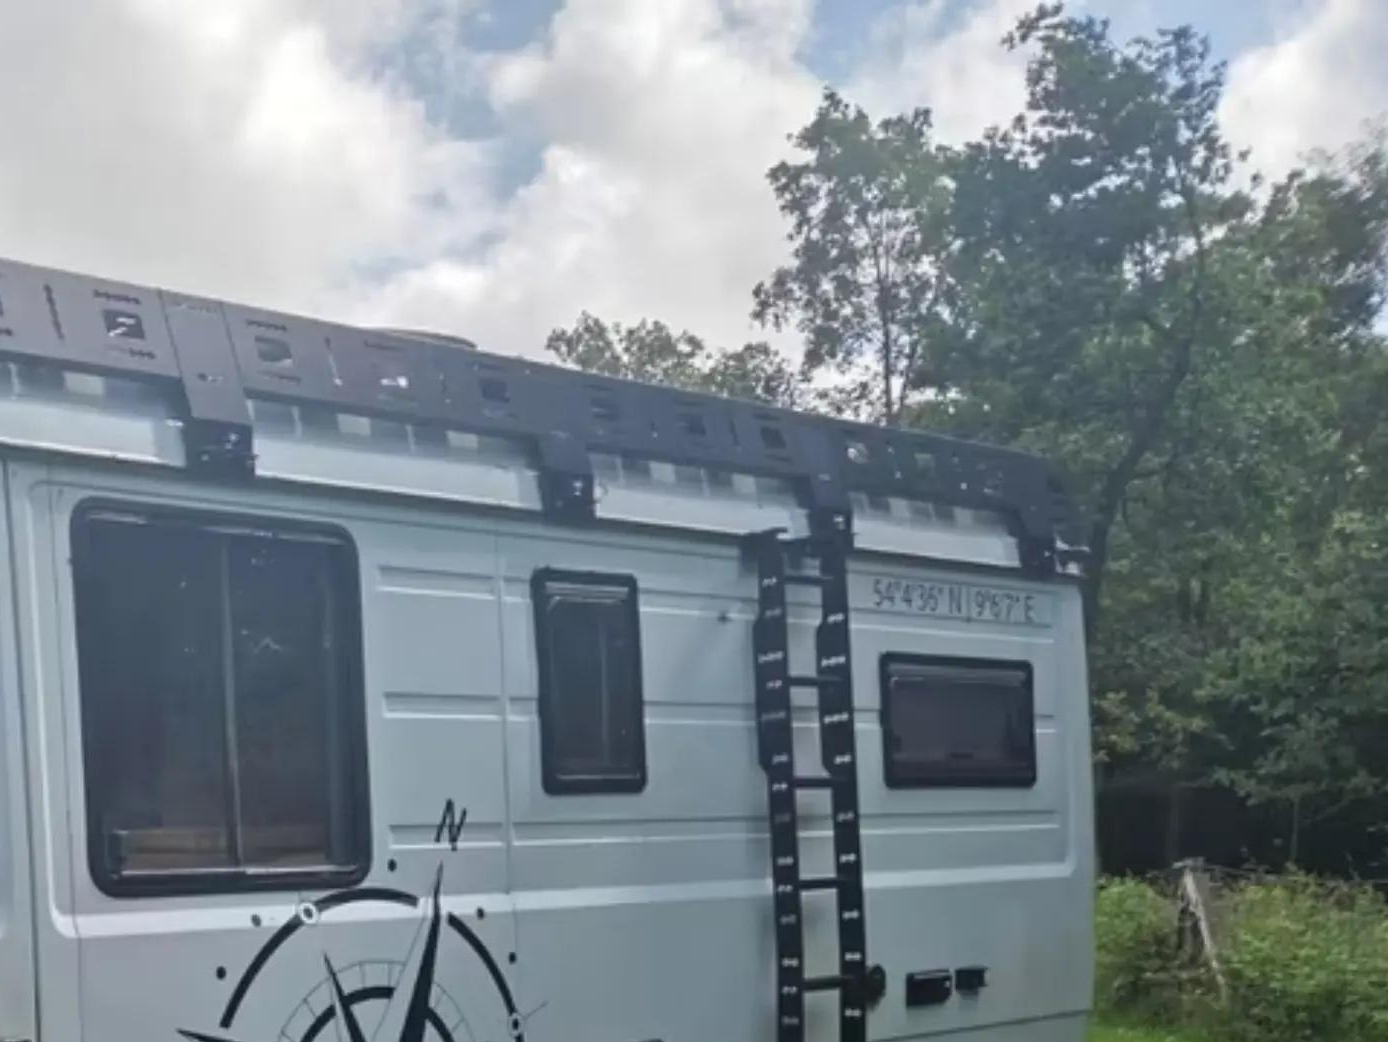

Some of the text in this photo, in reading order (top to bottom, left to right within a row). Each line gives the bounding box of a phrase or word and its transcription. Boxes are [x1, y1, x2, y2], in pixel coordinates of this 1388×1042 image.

[948, 585, 963, 615] N
[1024, 595, 1037, 623] E
[434, 798, 467, 851] N
